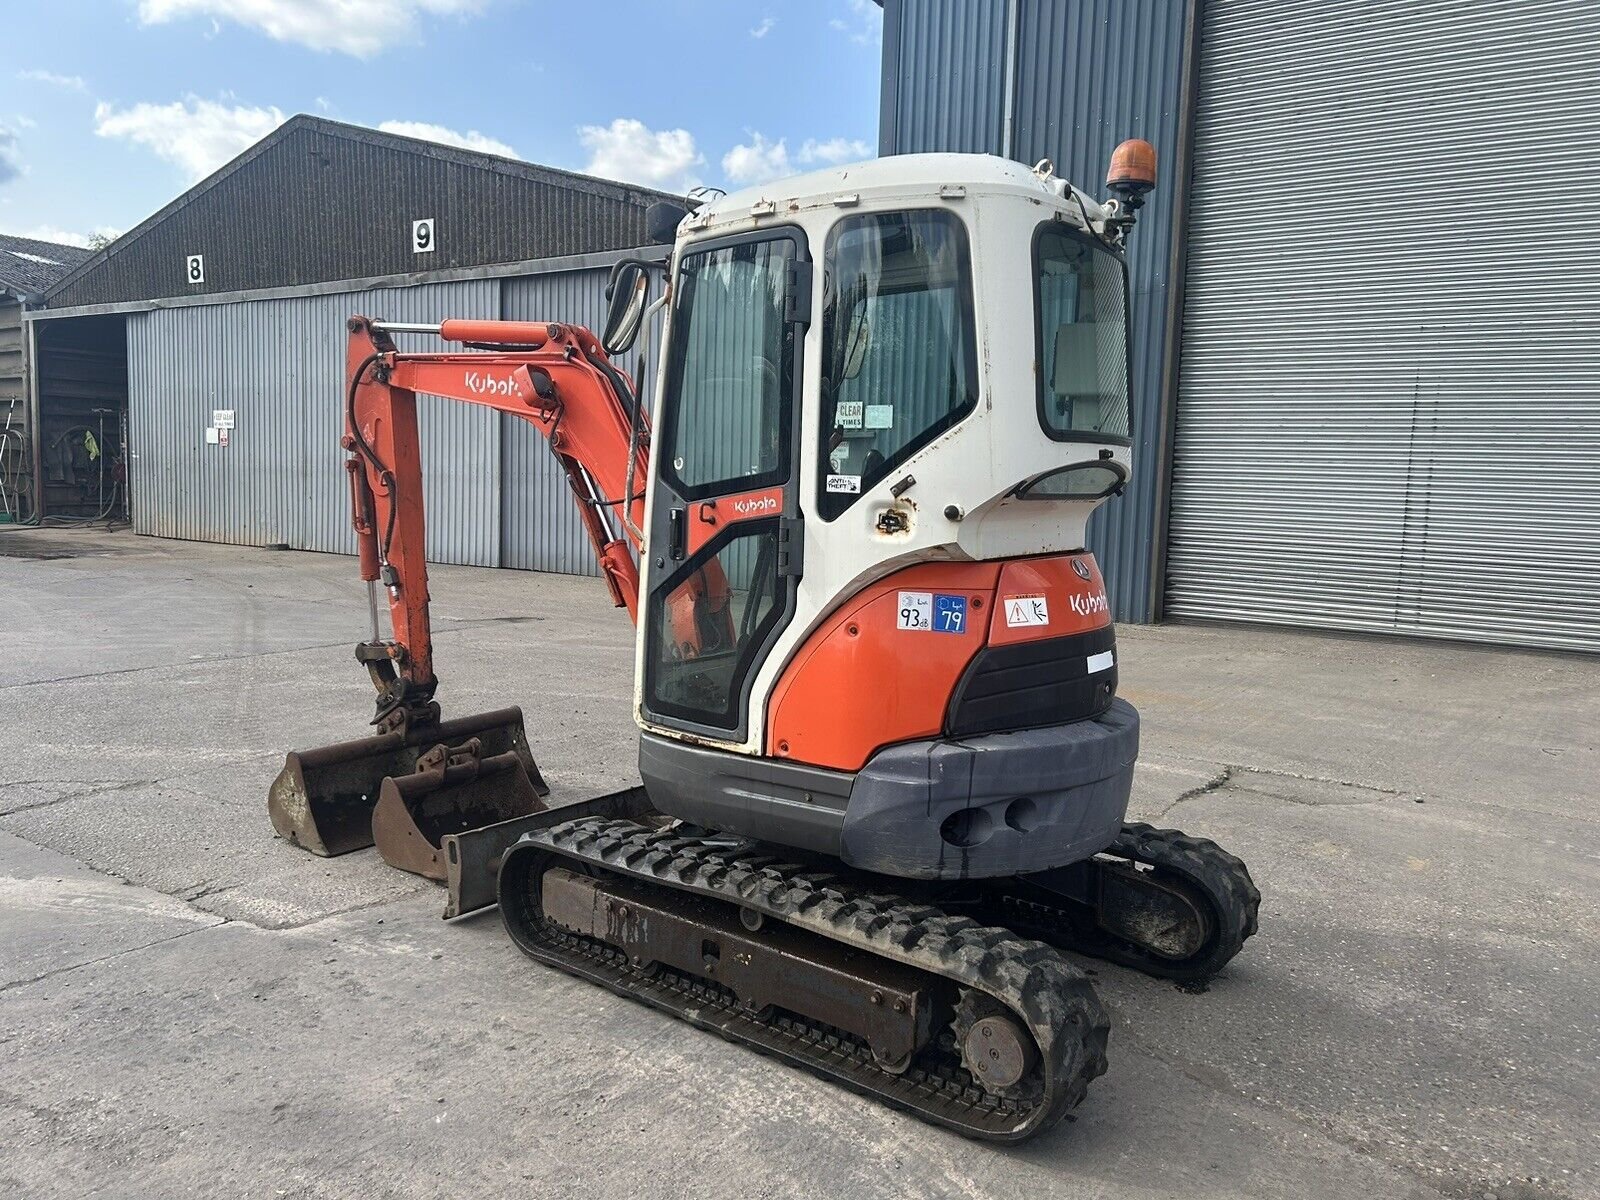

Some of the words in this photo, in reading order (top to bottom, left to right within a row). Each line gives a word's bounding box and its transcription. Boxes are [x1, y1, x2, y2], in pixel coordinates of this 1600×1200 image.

[416, 222, 431, 249] 9
[190, 258, 201, 281] 8
[840, 405, 861, 416] CLEAR
[734, 496, 777, 513] Kubota
[901, 608, 920, 627] 93
[919, 618, 929, 628] dB
[941, 610, 963, 631] 79
